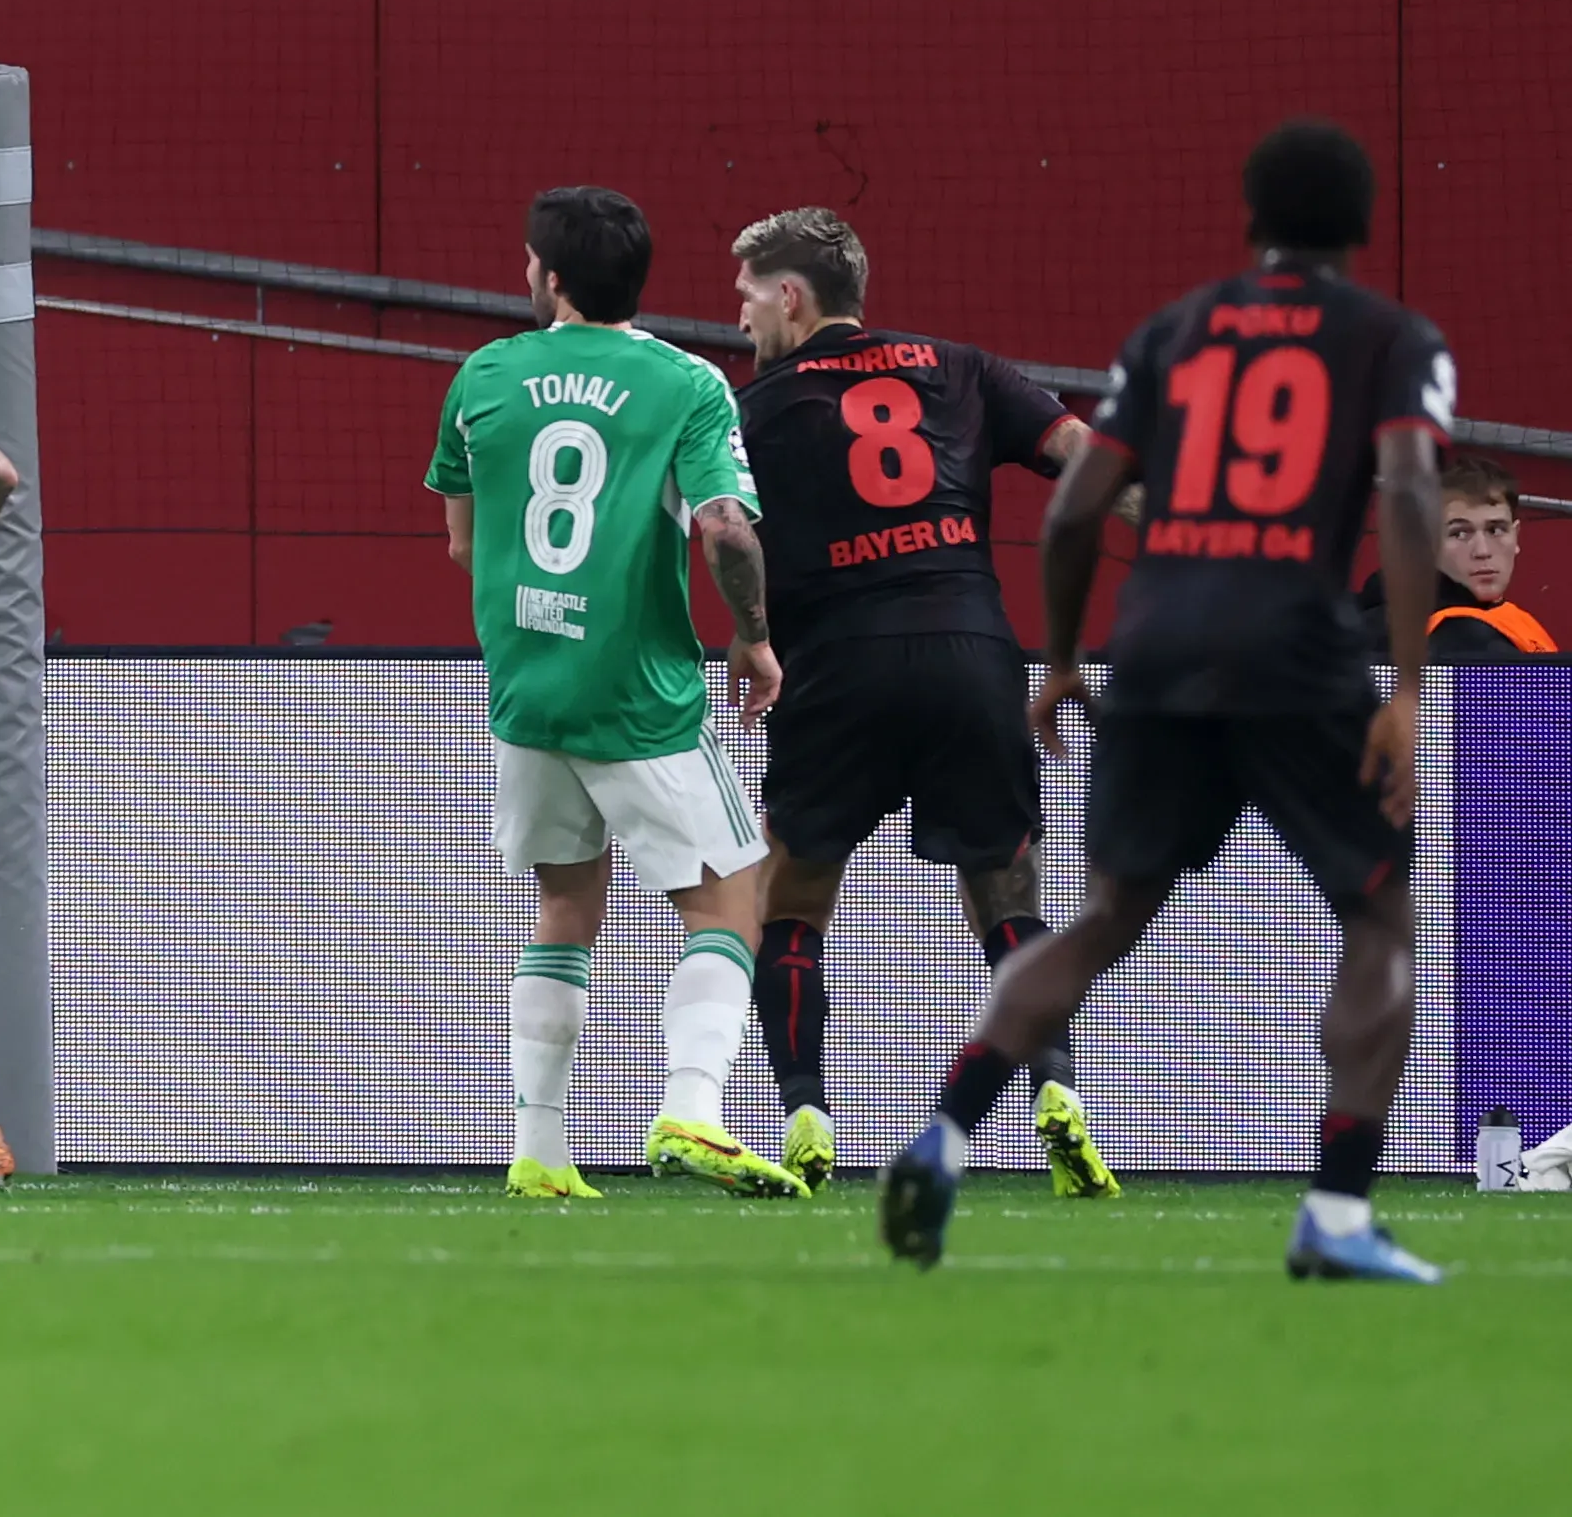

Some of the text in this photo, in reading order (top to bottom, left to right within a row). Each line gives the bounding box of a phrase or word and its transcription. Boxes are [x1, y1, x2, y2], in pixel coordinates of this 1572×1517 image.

[522, 369, 631, 417] TONALI
[1167, 345, 1332, 518] 19
[840, 377, 936, 508] 8
[524, 419, 608, 575] 8
[829, 515, 977, 568] BAYER 04
[528, 587, 589, 613] NEWCASTLE
